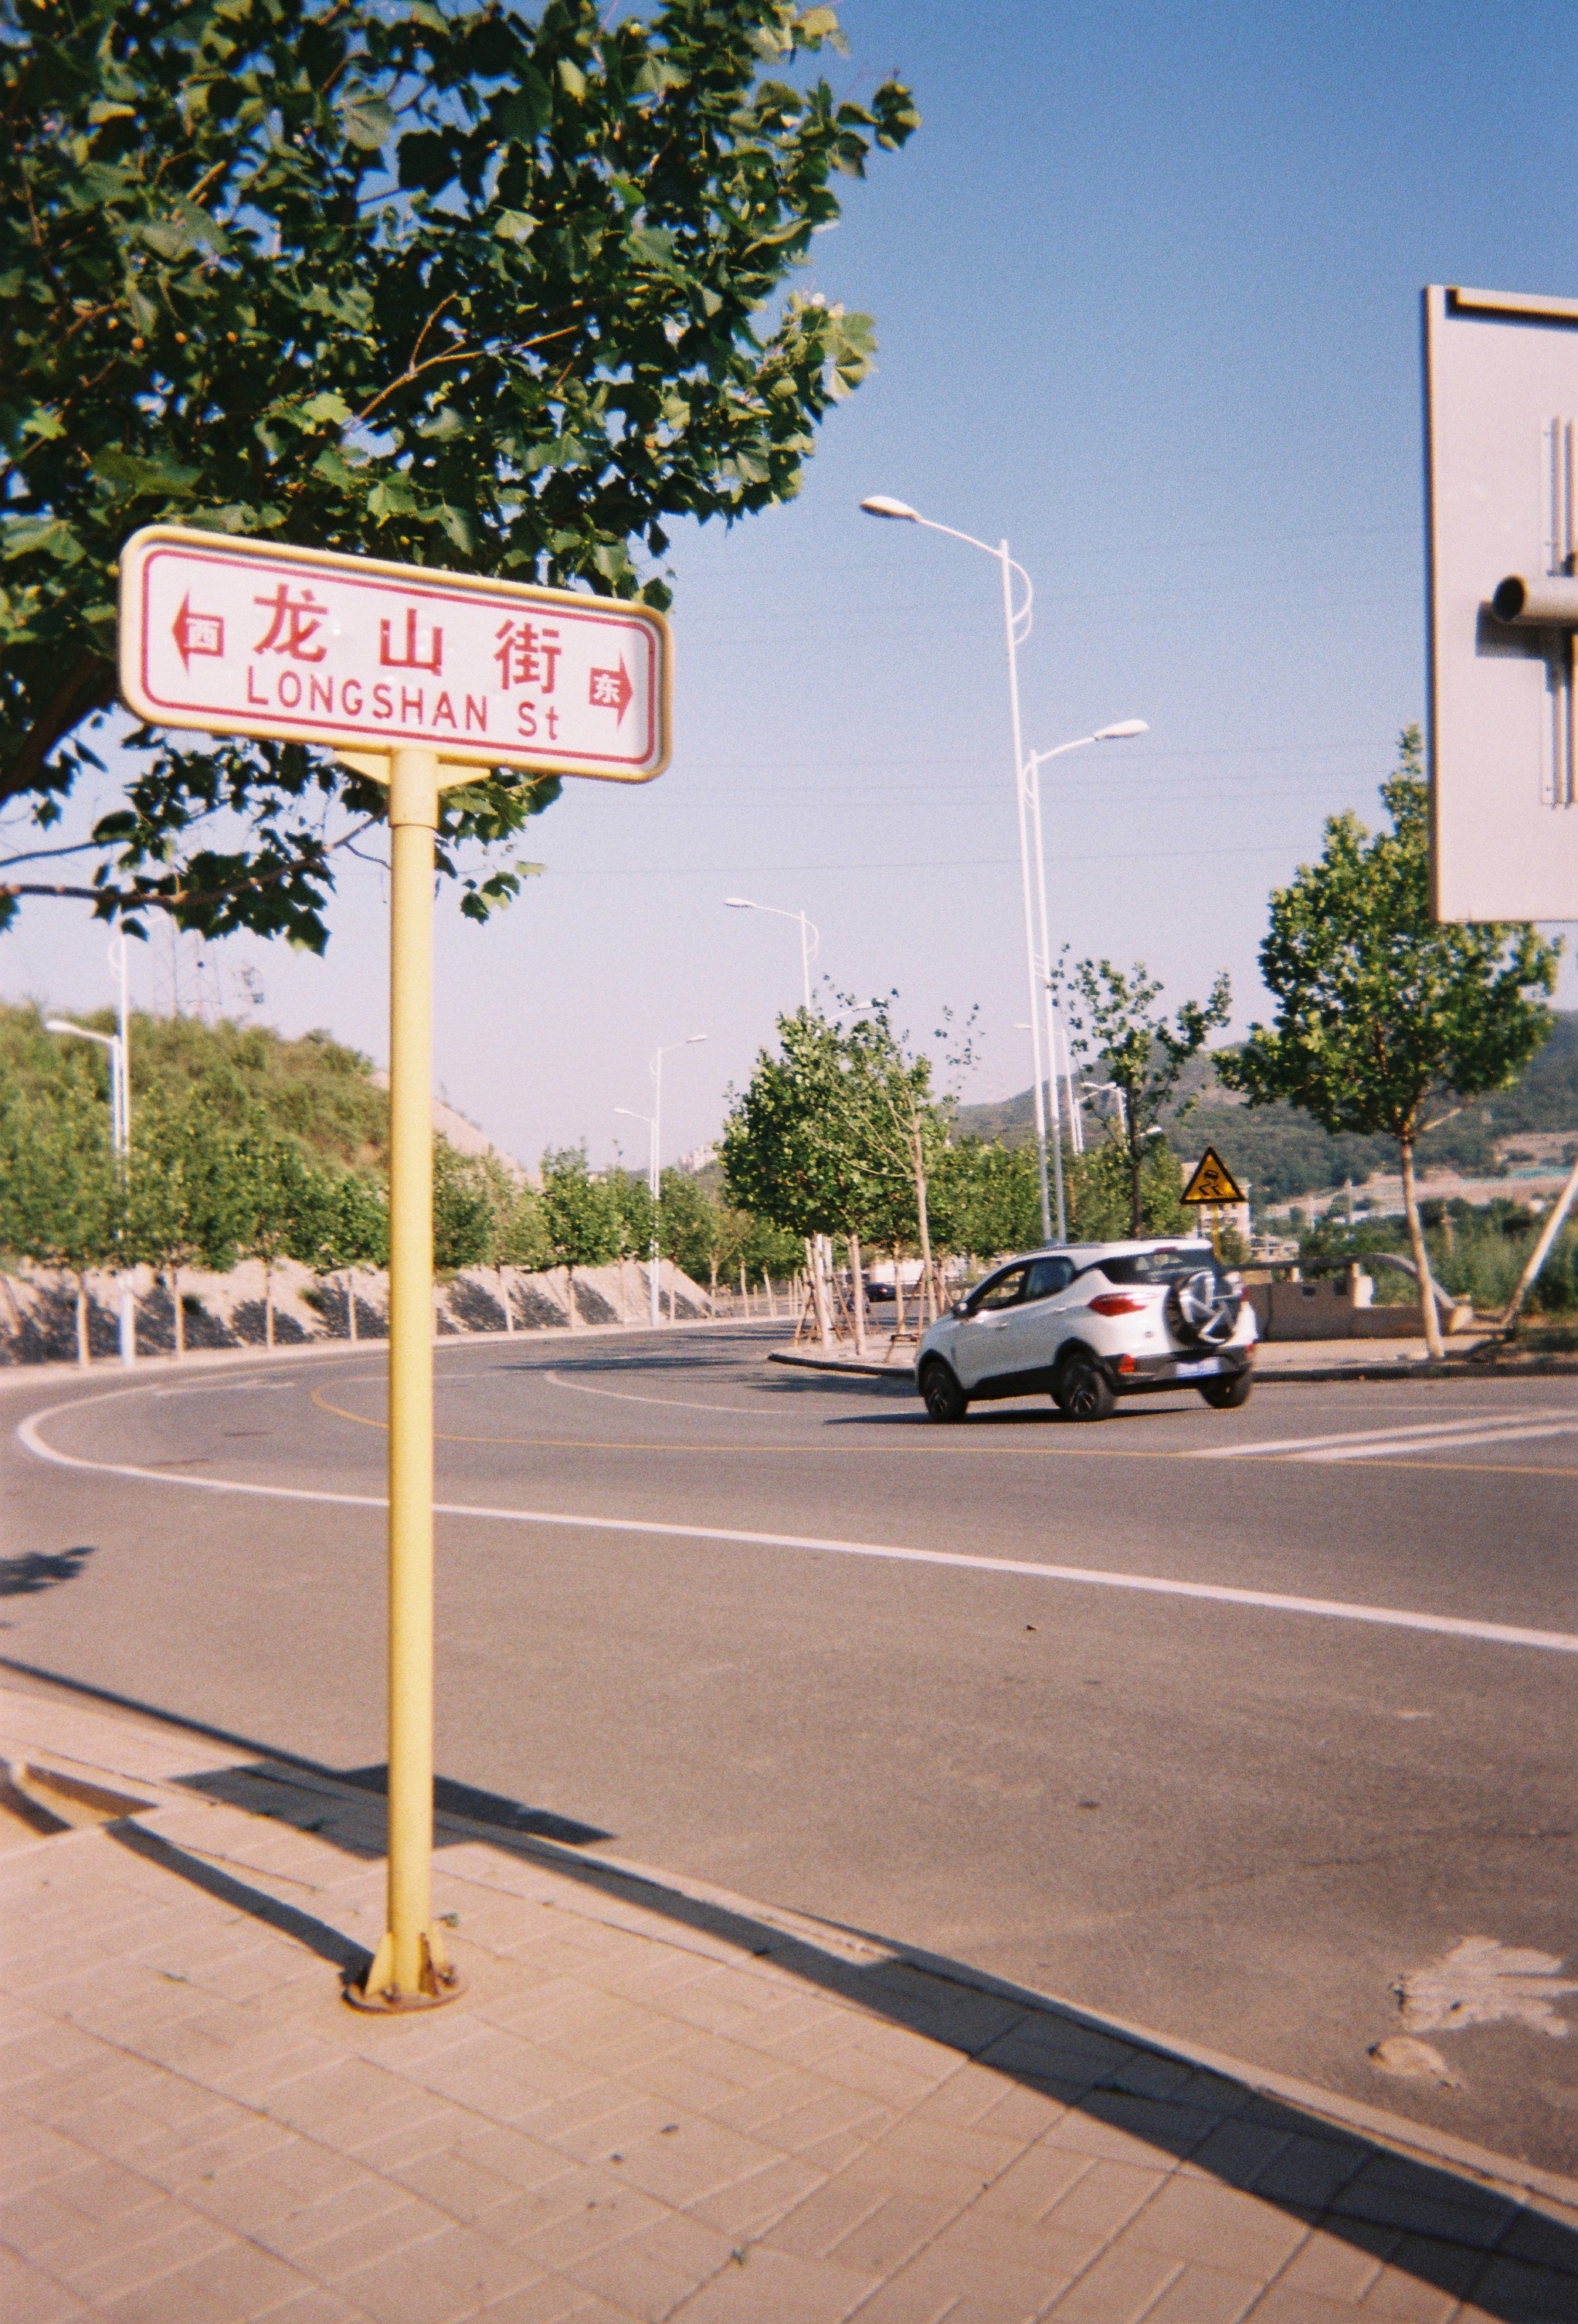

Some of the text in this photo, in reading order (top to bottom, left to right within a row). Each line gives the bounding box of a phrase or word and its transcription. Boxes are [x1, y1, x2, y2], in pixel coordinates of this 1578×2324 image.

[185, 618, 219, 650] 西
[253, 583, 562, 695] 龙山街
[246, 665, 558, 742] LONGSHAN St
[592, 672, 621, 704] 东
